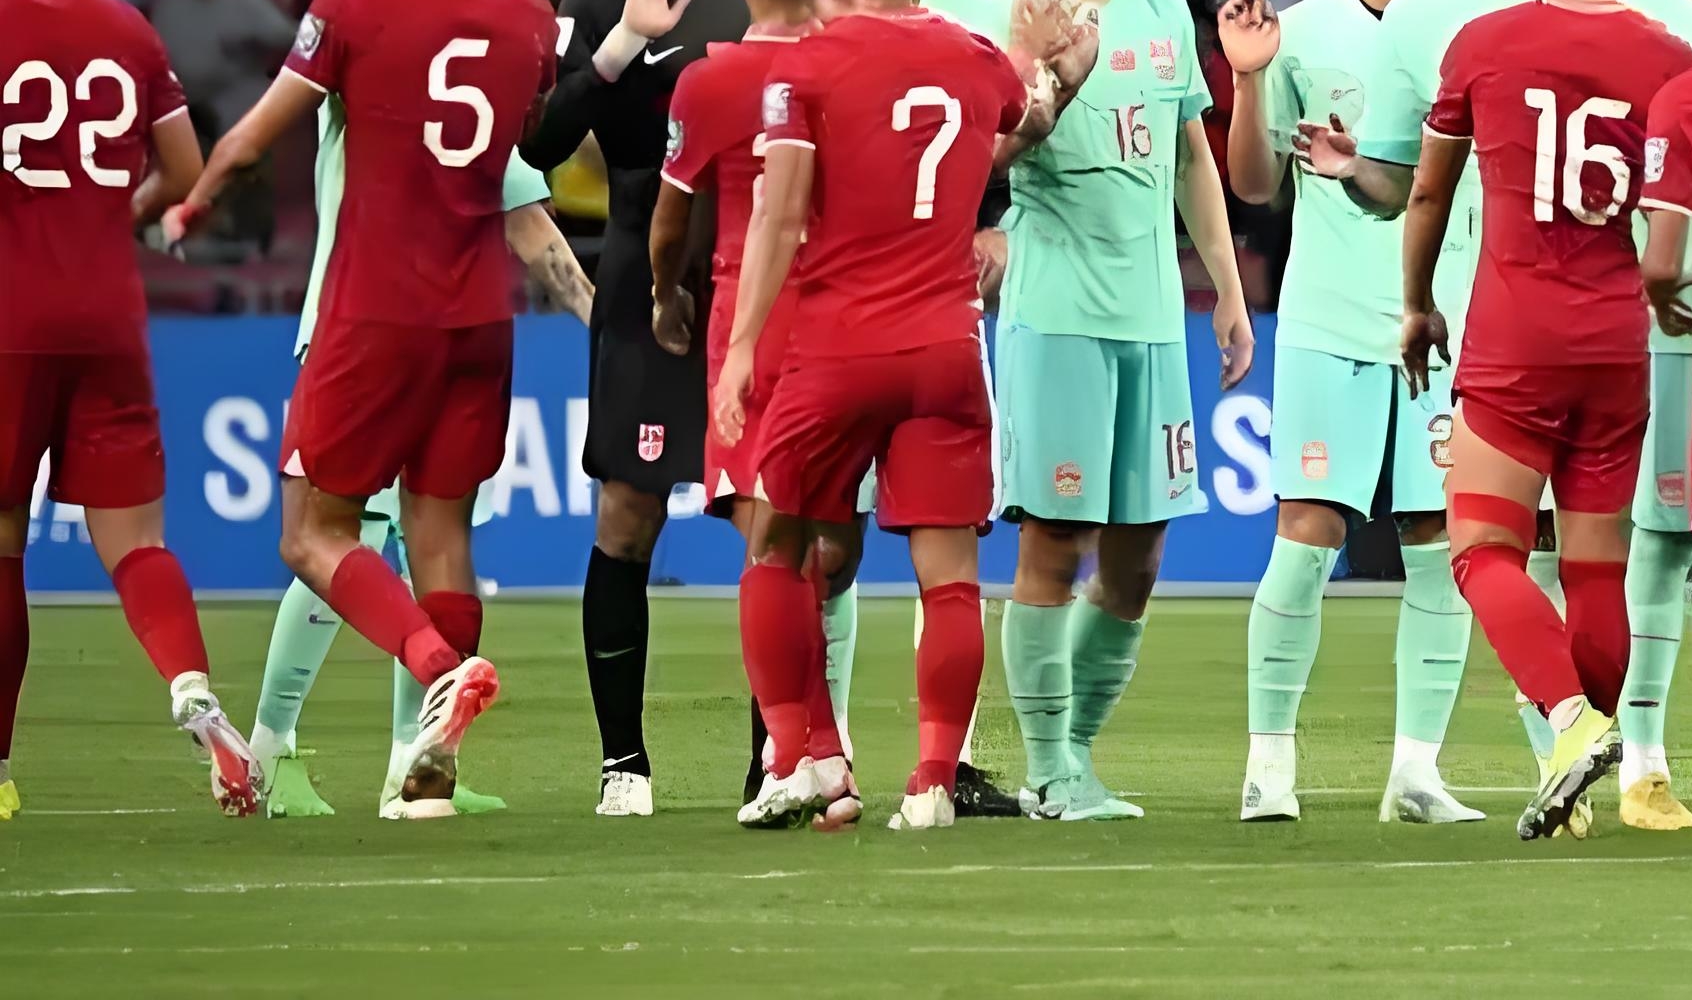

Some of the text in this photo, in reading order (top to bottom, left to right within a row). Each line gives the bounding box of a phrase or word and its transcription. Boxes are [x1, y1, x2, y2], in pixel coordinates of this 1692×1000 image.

[2, 58, 138, 188] 22
[424, 38, 493, 168] 5
[891, 85, 962, 220] 7
[1524, 87, 1632, 226] 16
